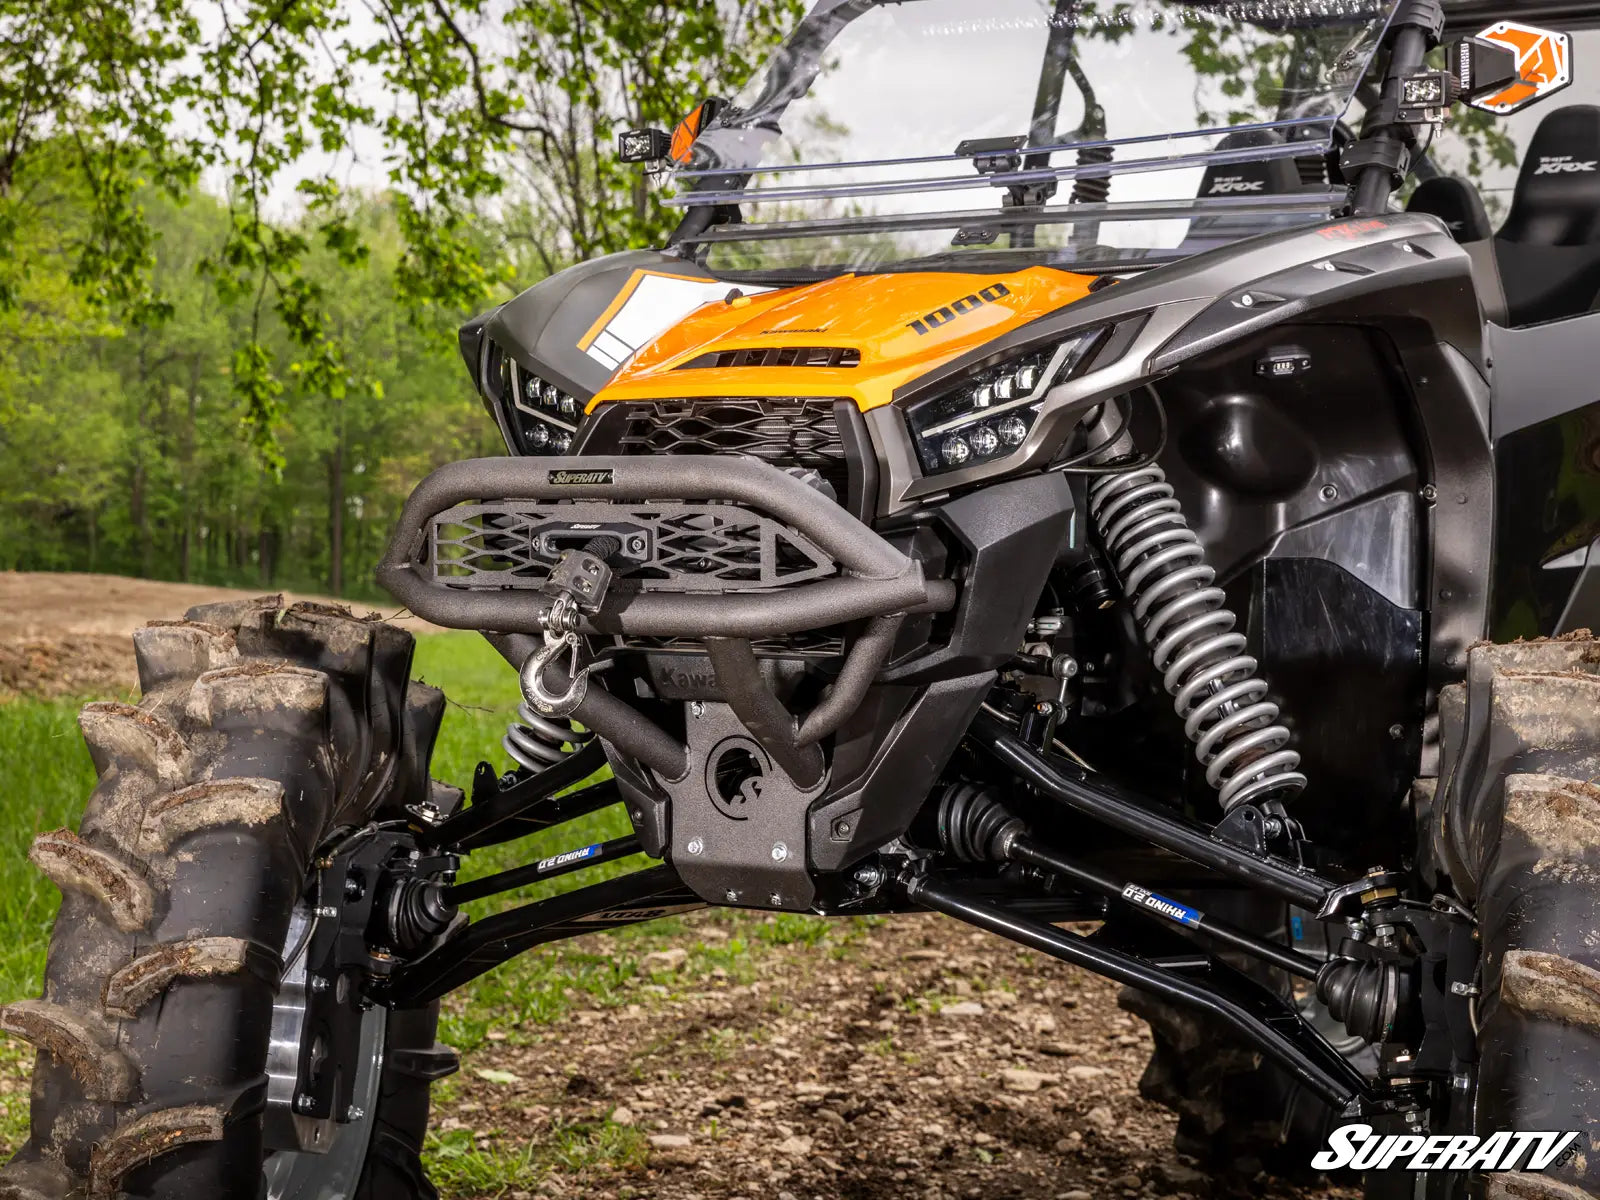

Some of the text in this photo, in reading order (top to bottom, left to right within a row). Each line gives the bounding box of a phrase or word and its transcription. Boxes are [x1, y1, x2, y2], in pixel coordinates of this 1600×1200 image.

[1534, 160, 1598, 175] KRX
[1208, 181, 1265, 194] KRX
[906, 282, 1012, 336] 1000
[554, 471, 609, 484] SUPERATV
[661, 667, 717, 690] Kawa
[538, 847, 591, 870] RHINO 2.0
[1122, 887, 1187, 920] RHINO 2.0
